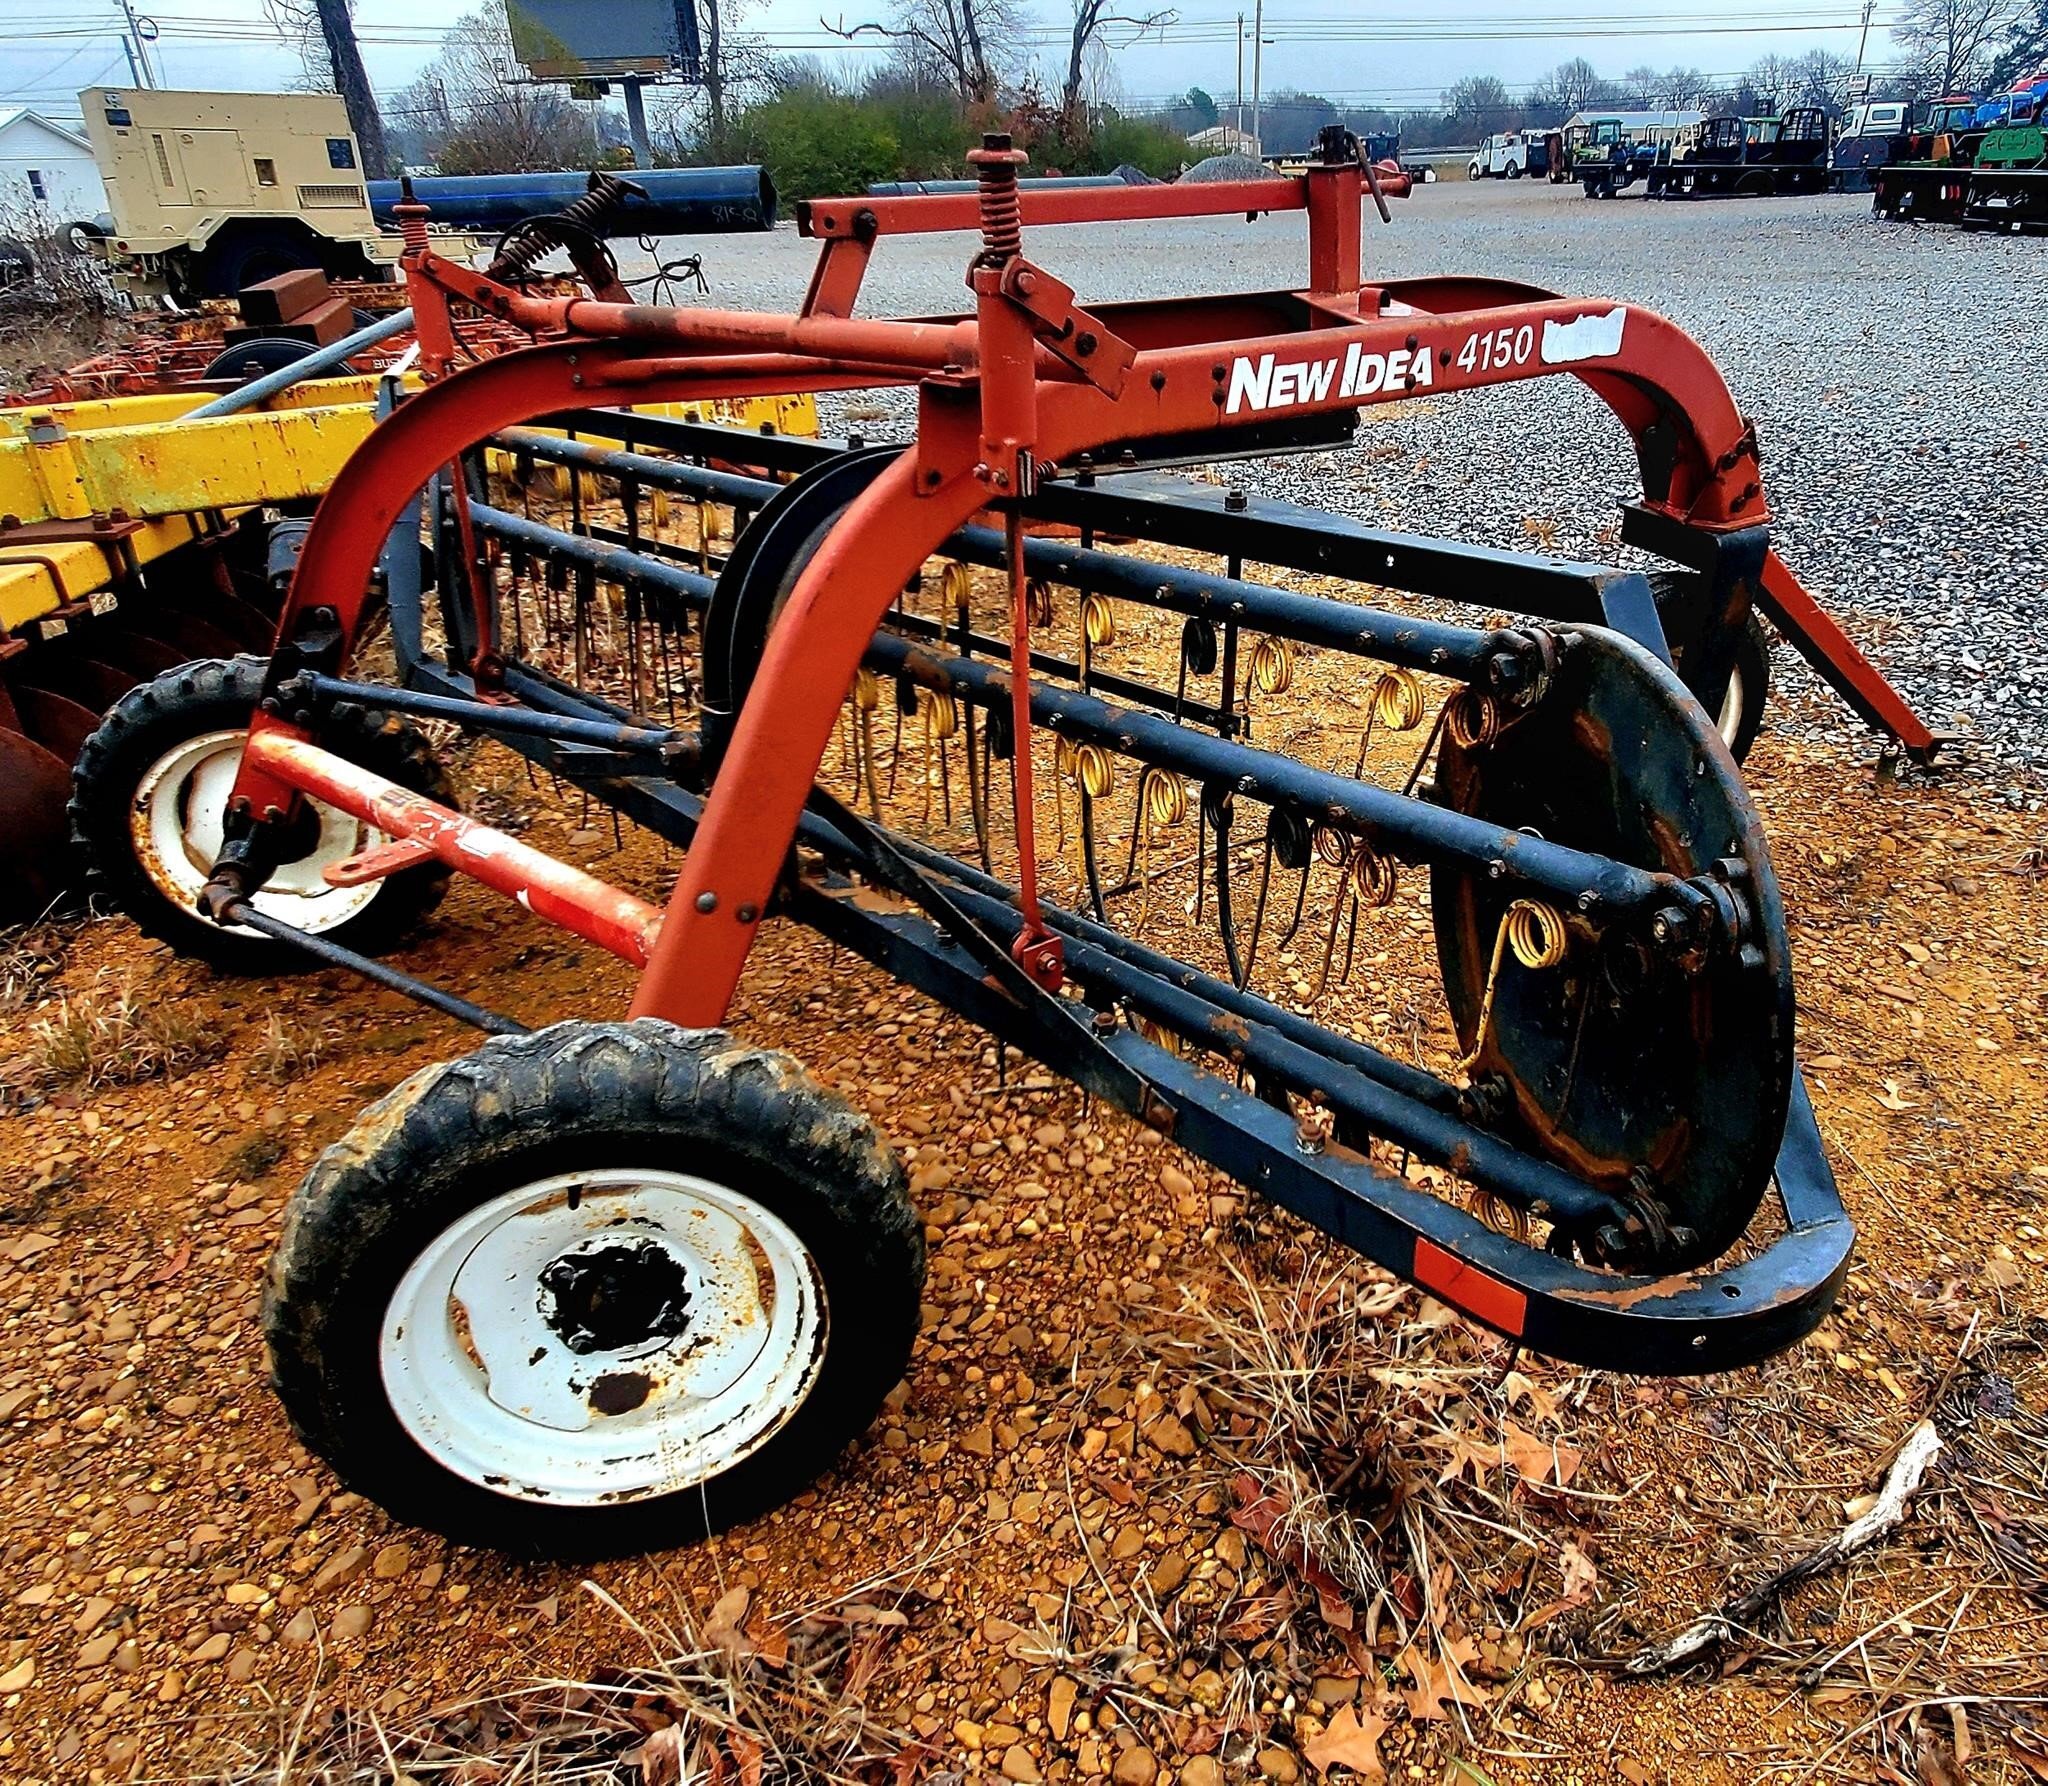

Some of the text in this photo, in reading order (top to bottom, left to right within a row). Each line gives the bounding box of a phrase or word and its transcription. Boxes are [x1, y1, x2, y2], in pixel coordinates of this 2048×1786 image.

[1225, 324, 1534, 415] NEW IDEA 4150
